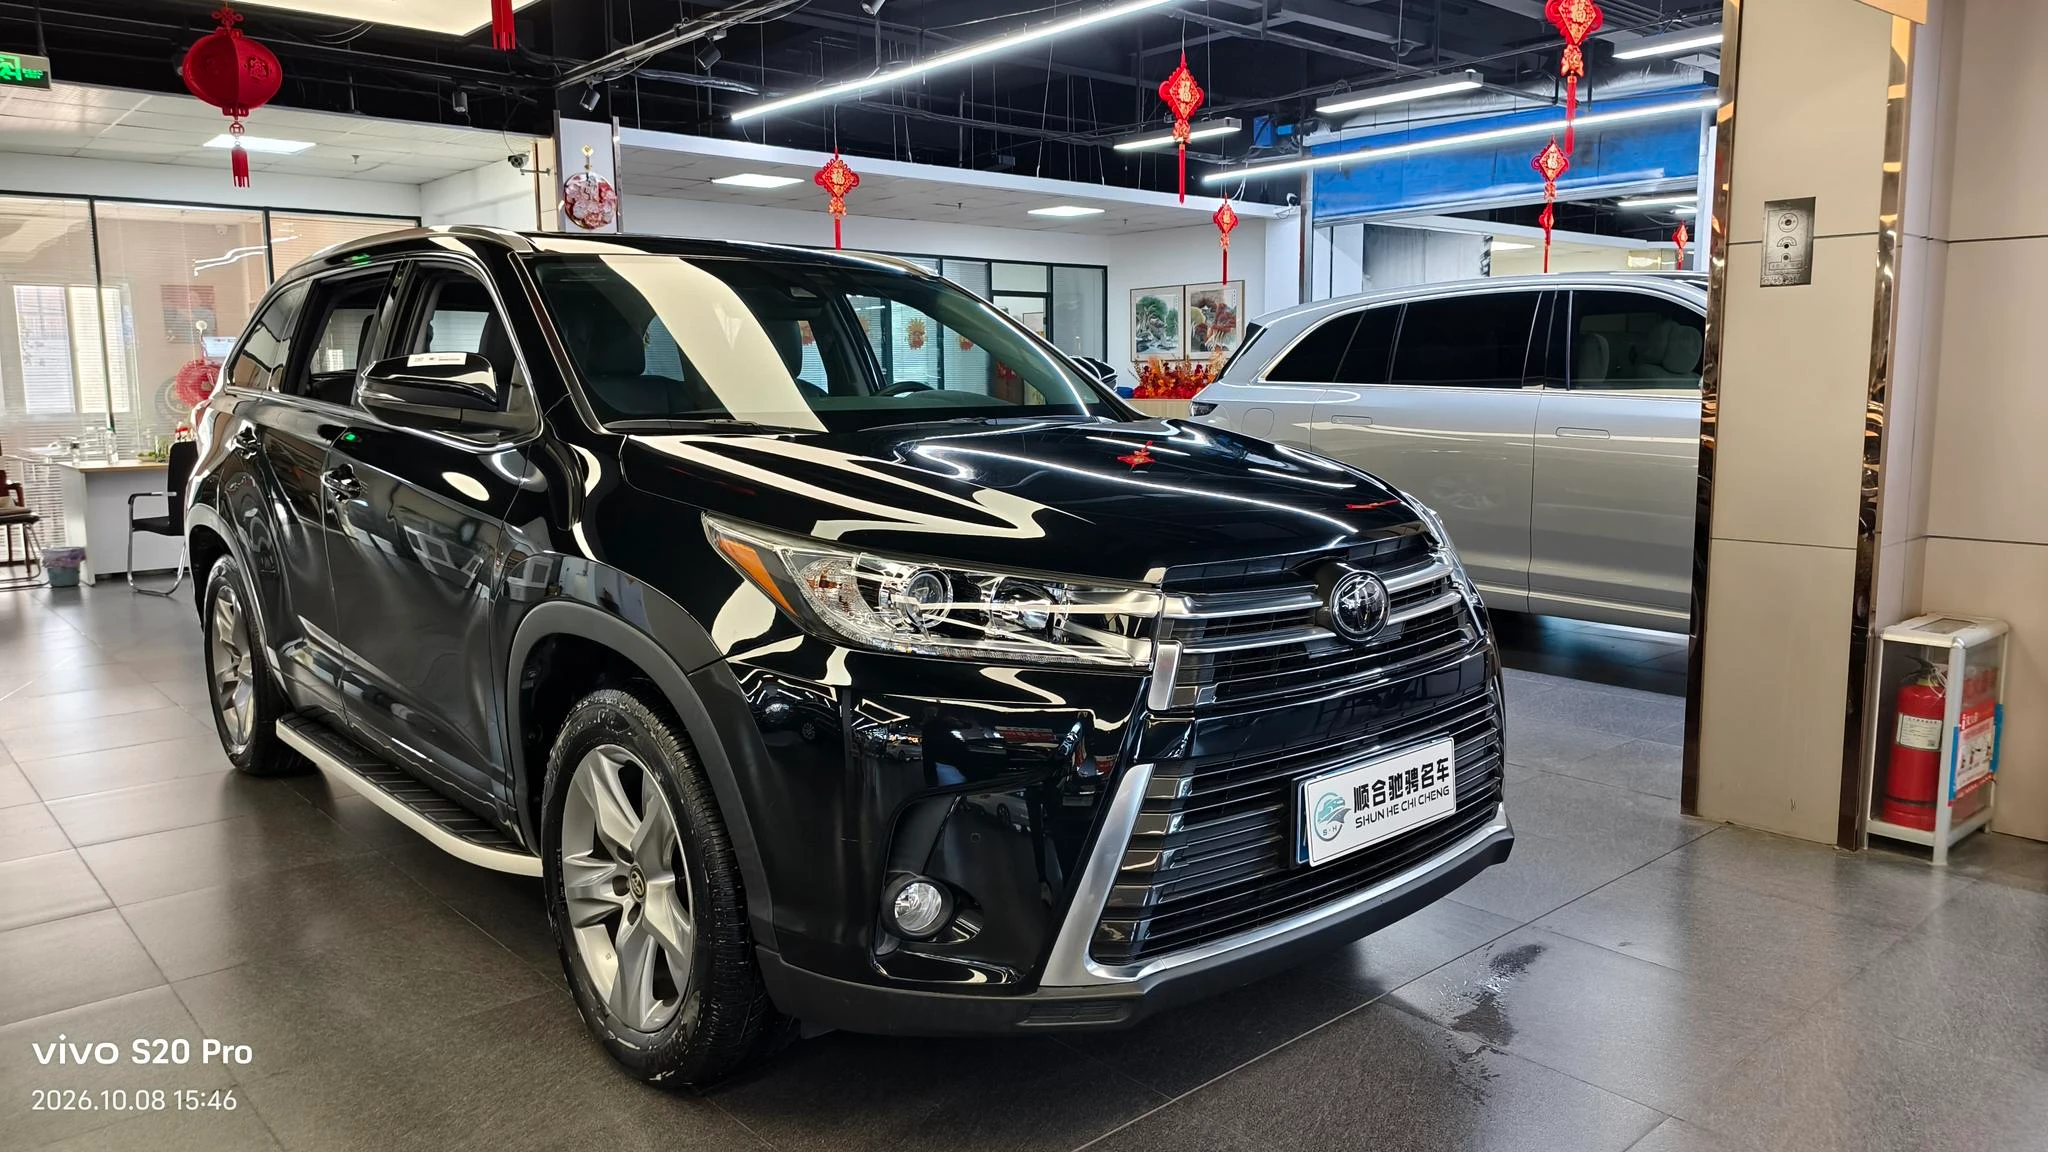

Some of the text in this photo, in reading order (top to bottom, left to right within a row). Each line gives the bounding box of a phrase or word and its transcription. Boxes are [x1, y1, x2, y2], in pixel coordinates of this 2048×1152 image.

[1353, 757, 1450, 814] 顺合驰骋名车
[1355, 785, 1450, 829] SHUN HE CHI CHENG
